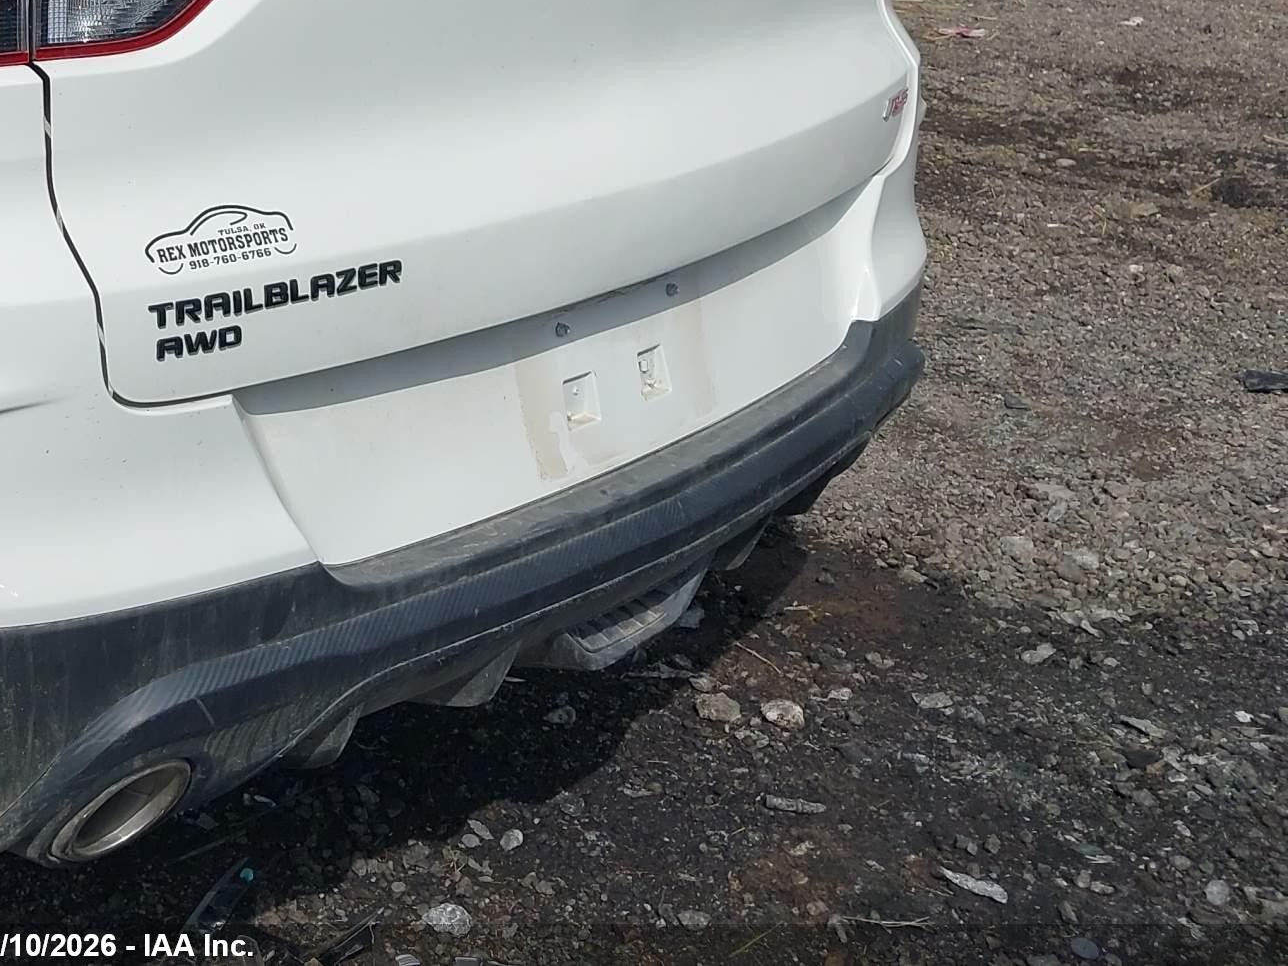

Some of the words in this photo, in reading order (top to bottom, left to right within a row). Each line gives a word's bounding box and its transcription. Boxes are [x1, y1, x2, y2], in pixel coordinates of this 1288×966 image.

[253, 222, 266, 231] OK
[156, 244, 187, 263] REX
[187, 227, 289, 258] MOTORSPORTS
[188, 247, 272, 270] 918-760-6766
[148, 259, 403, 329] TRAILBLAZER
[156, 324, 243, 362] AWD
